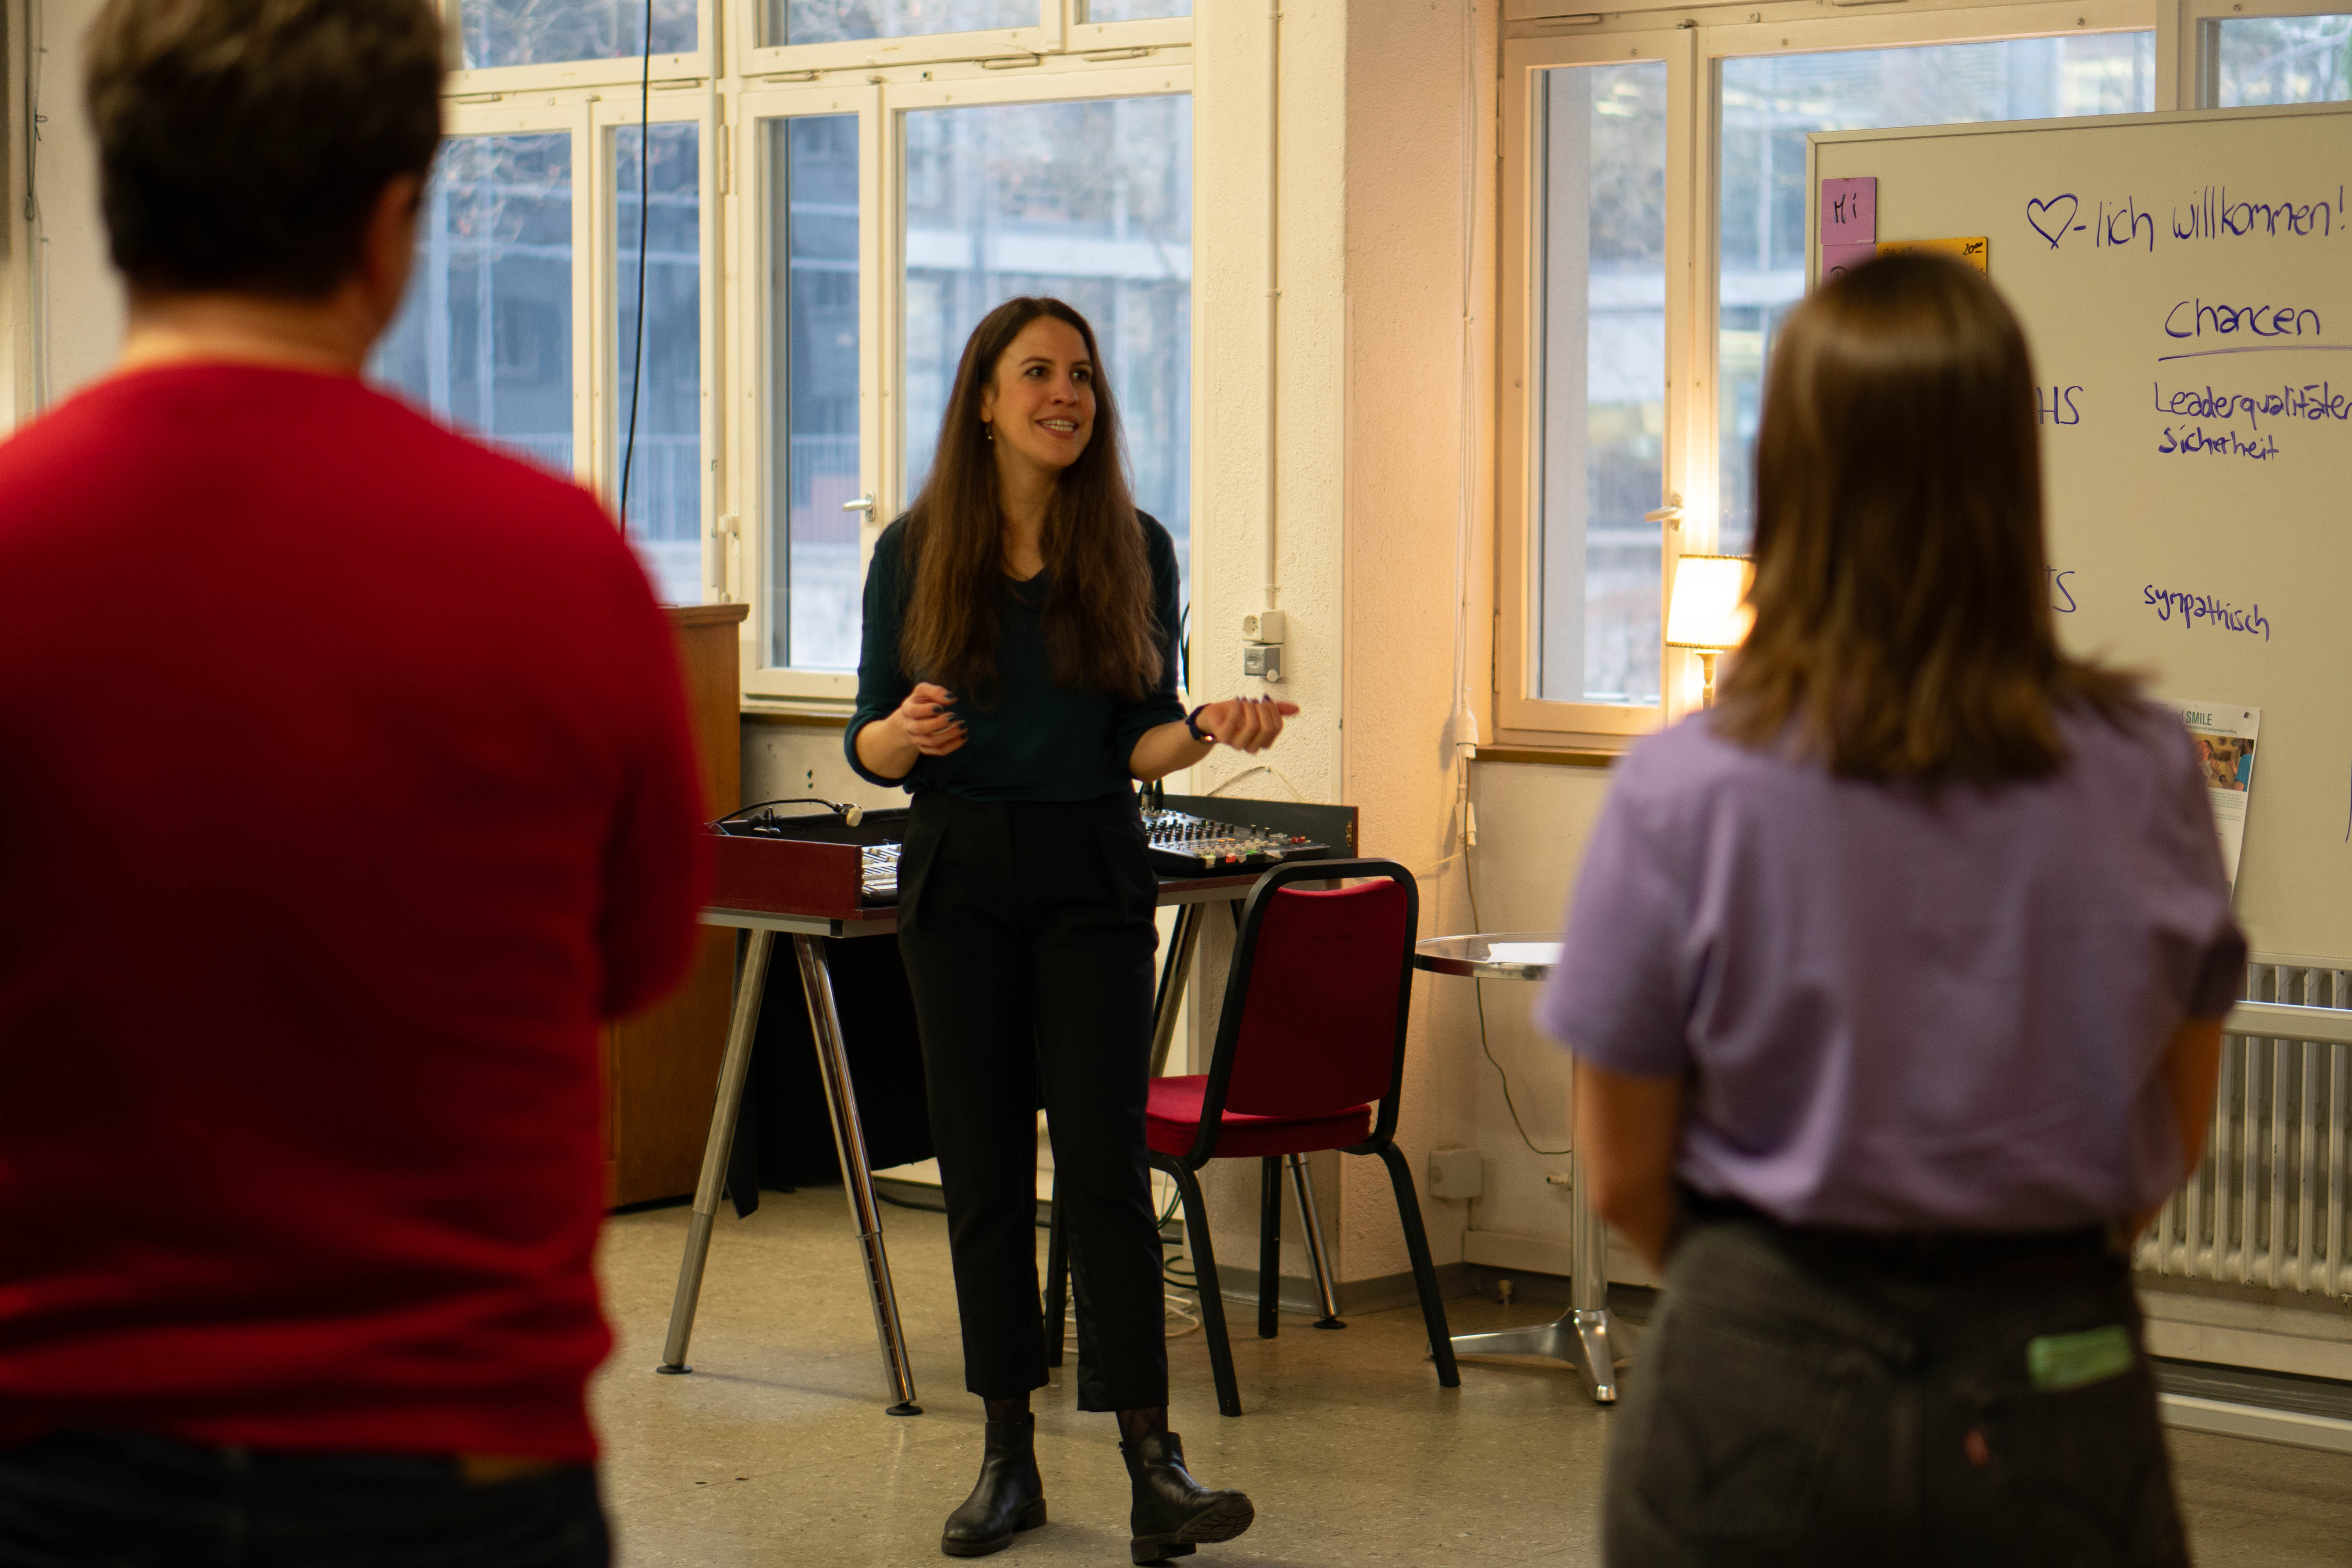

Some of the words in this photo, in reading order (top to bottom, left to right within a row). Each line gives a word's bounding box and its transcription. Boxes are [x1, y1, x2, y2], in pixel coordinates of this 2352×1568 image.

[2173, 185, 2345, 238] willkommen!
[2165, 298, 2321, 338] Chancen
[2144, 584, 2270, 642] sympathisch
[2186, 711, 2212, 726] SMILE
